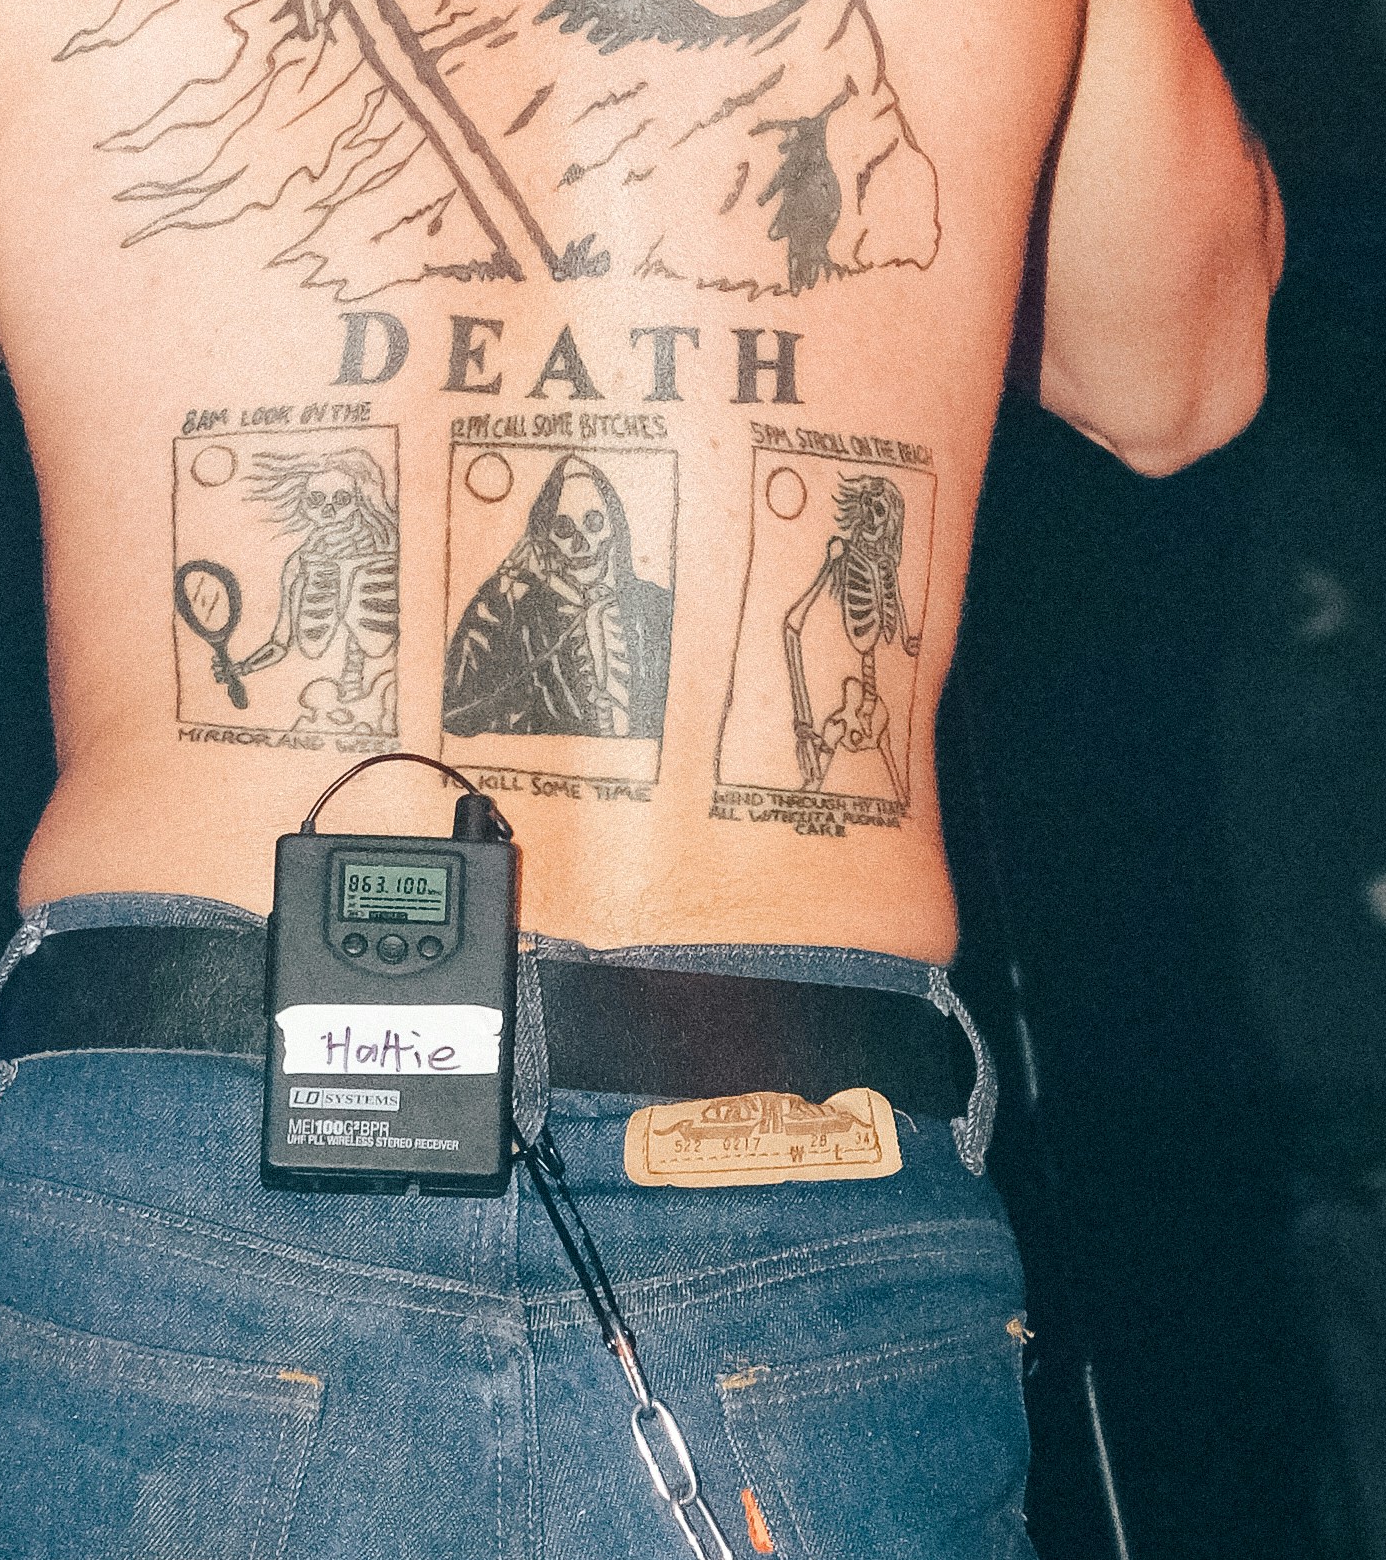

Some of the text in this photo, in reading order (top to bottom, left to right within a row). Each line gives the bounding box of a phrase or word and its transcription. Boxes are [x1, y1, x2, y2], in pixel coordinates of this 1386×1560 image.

[330, 311, 804, 406] DEATH
[241, 405, 294, 427] LOOK
[332, 401, 371, 423] THE
[532, 412, 573, 438] SOME
[579, 413, 668, 439] BITCHES
[795, 427, 850, 454] STROLL
[178, 727, 278, 747] MIRROR
[479, 774, 524, 792] KILL
[531, 775, 582, 799] SOME
[591, 783, 652, 803] TIME
[321, 1026, 461, 1072] Hattie
[293, 1090, 398, 1106] LD SYSTEMS
[287, 1134, 460, 1151] UHF PLL WIRELESS STEREO RECEIVER
[790, 1145, 805, 1163] W
[835, 1144, 843, 1161] L
